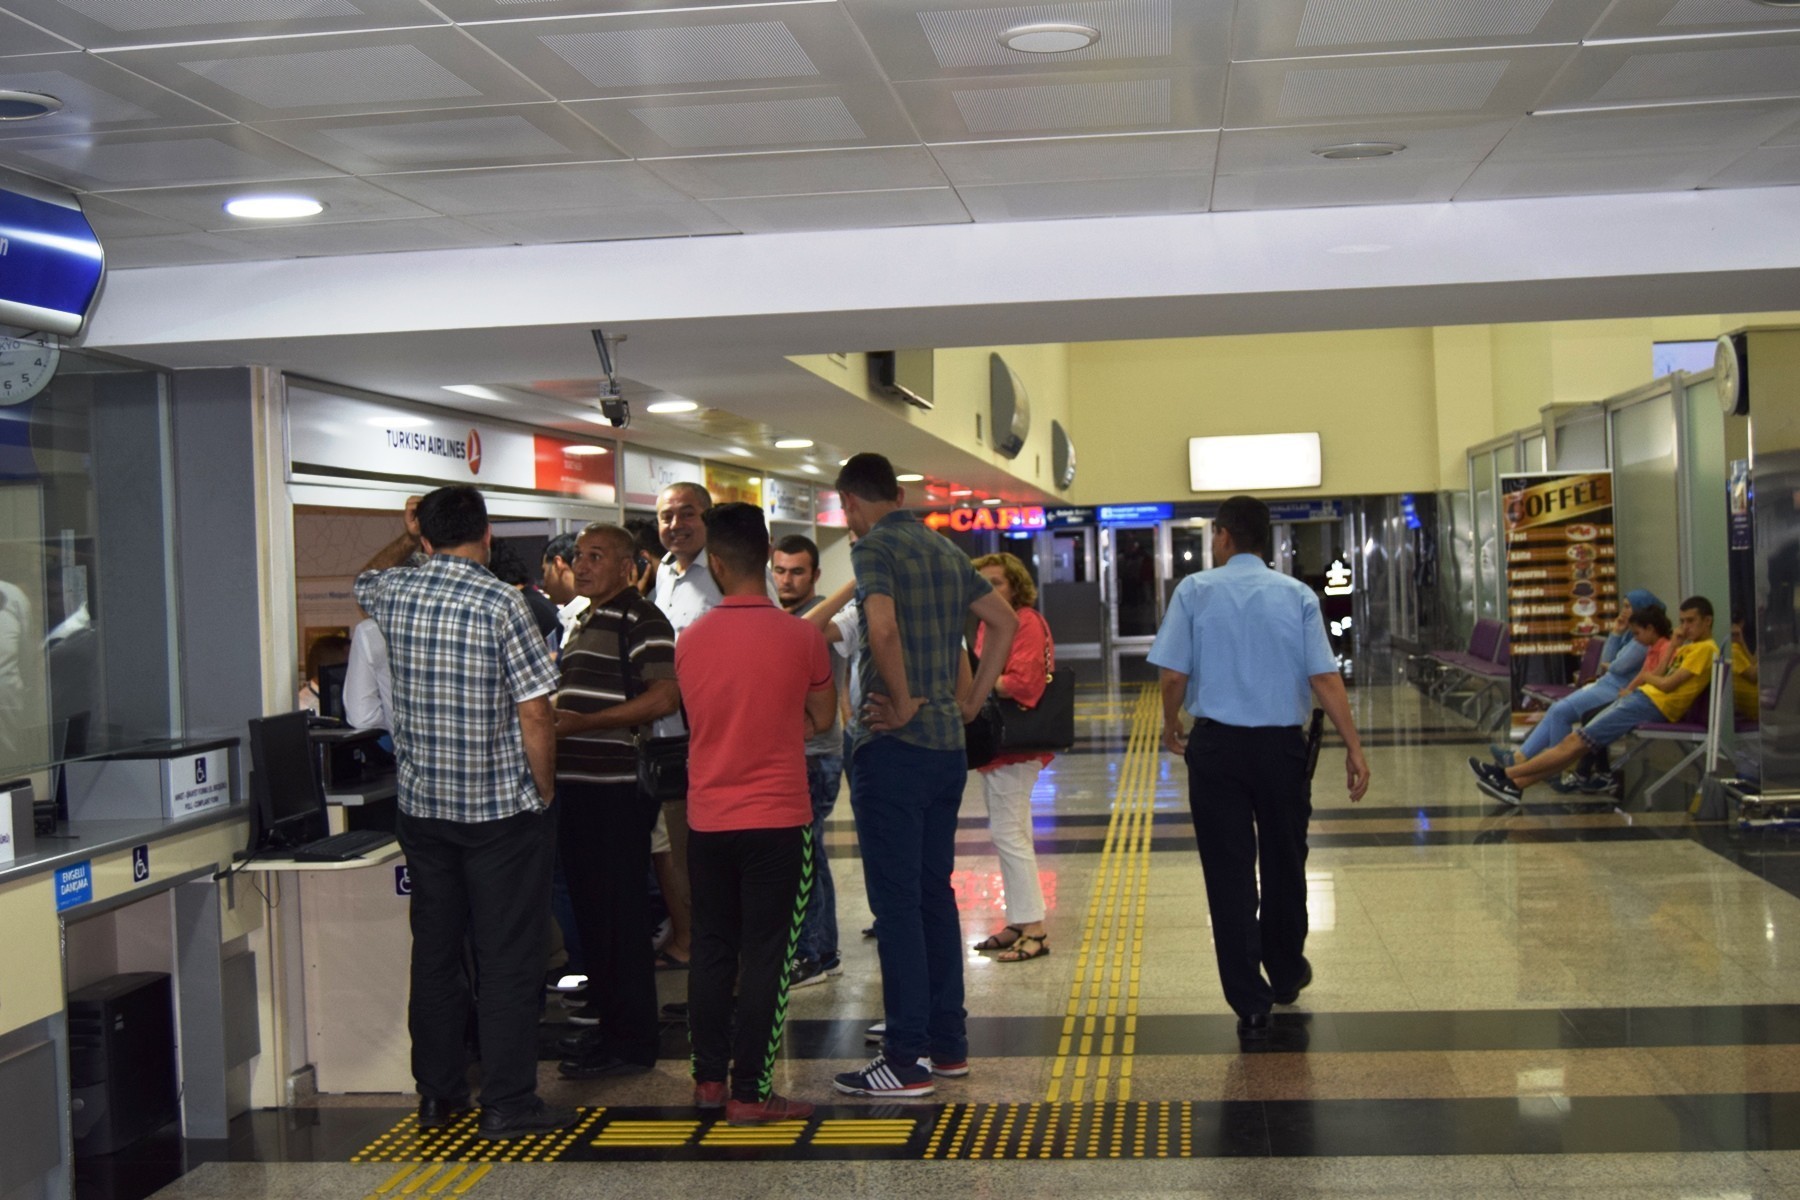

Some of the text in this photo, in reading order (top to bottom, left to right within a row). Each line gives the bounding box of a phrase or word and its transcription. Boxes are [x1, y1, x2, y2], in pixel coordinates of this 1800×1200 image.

[34, 358, 42, 367] 4
[3, 380, 12, 390] 6
[21, 373, 30, 383] 5
[386, 429, 466, 460] TURKISH AIRLINES
[1508, 480, 1606, 523] COFFEE
[950, 506, 1043, 532] CAFE
